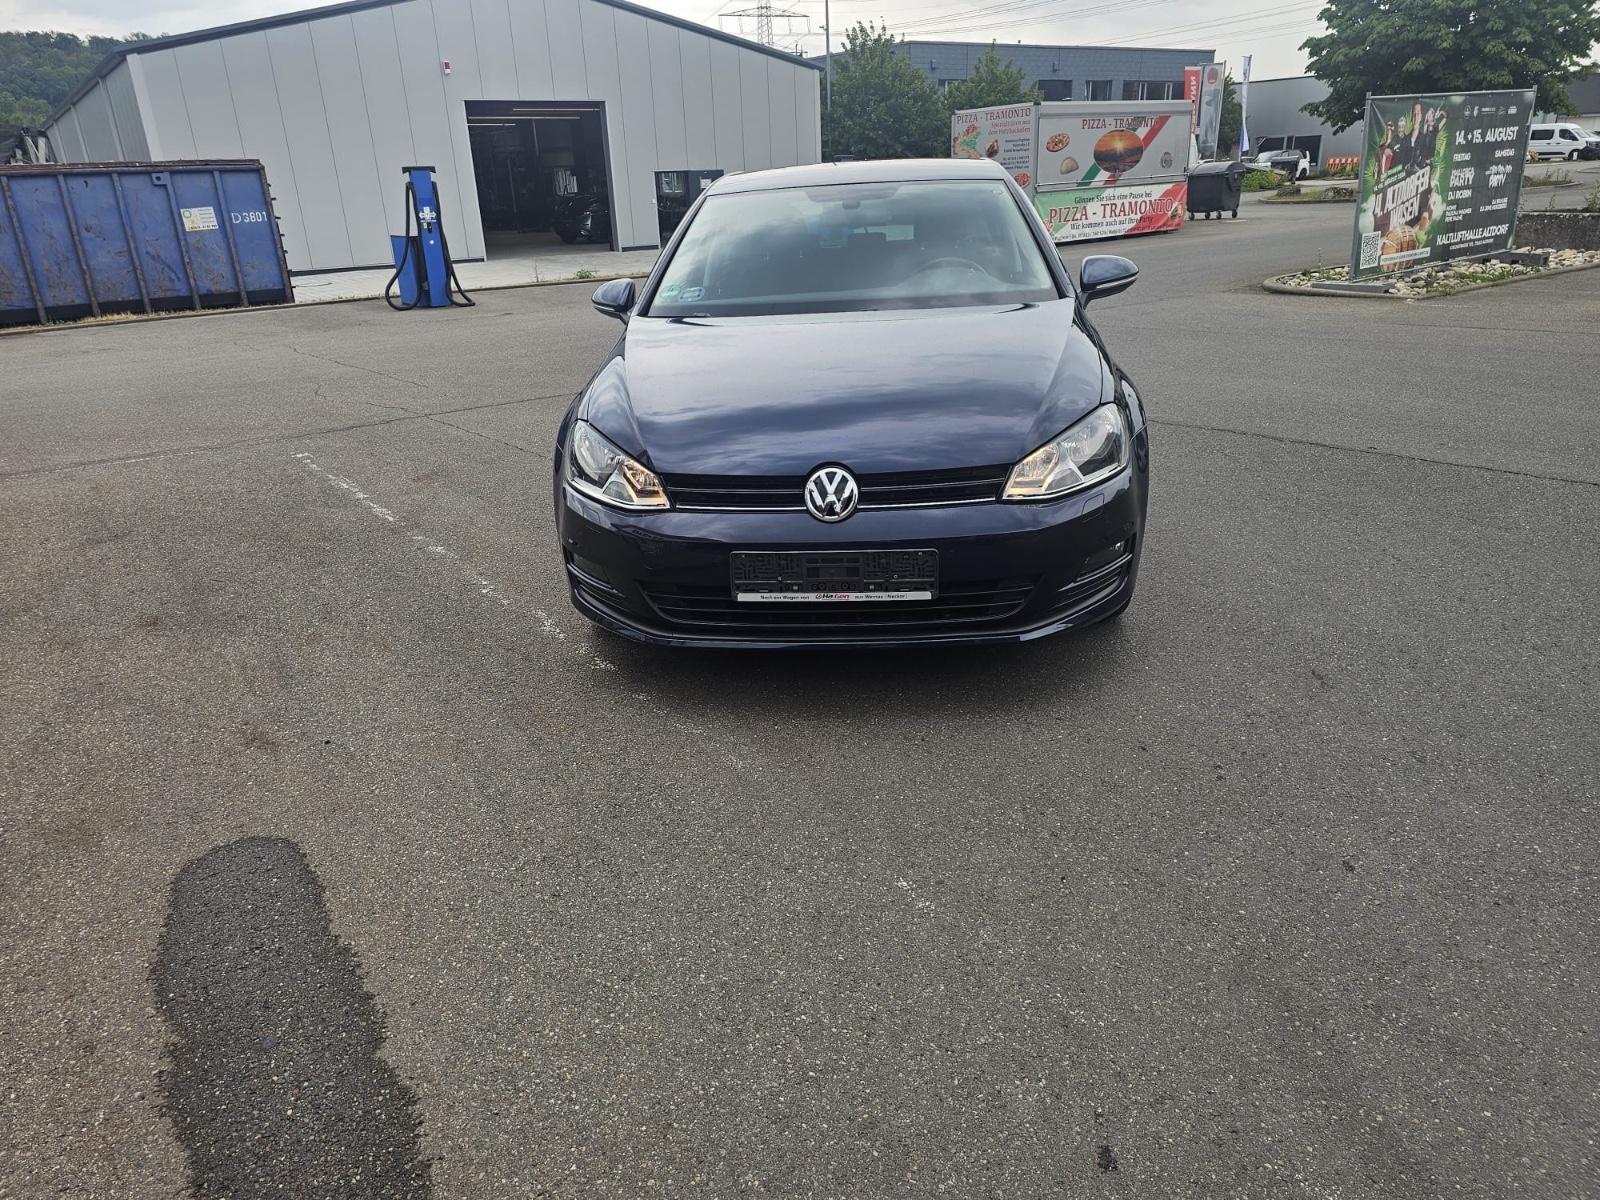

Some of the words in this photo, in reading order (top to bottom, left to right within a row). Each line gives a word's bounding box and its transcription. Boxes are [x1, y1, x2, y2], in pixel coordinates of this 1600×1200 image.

[957, 113, 978, 124] PIZZA
[985, 108, 1031, 121] TRAMONTO
[1082, 118, 1106, 129] PIZZA
[1455, 130, 1466, 146] 14.
[1473, 129, 1483, 144] 15.
[1484, 126, 1519, 143] AUGUST
[1450, 174, 1474, 188] PARTY
[1129, 192, 1143, 200] Pause
[243, 211, 268, 223] 3801
[1049, 206, 1088, 224] PIZZA
[1101, 198, 1173, 219] TRAMONTO
[1482, 223, 1509, 238] ALTDORF
